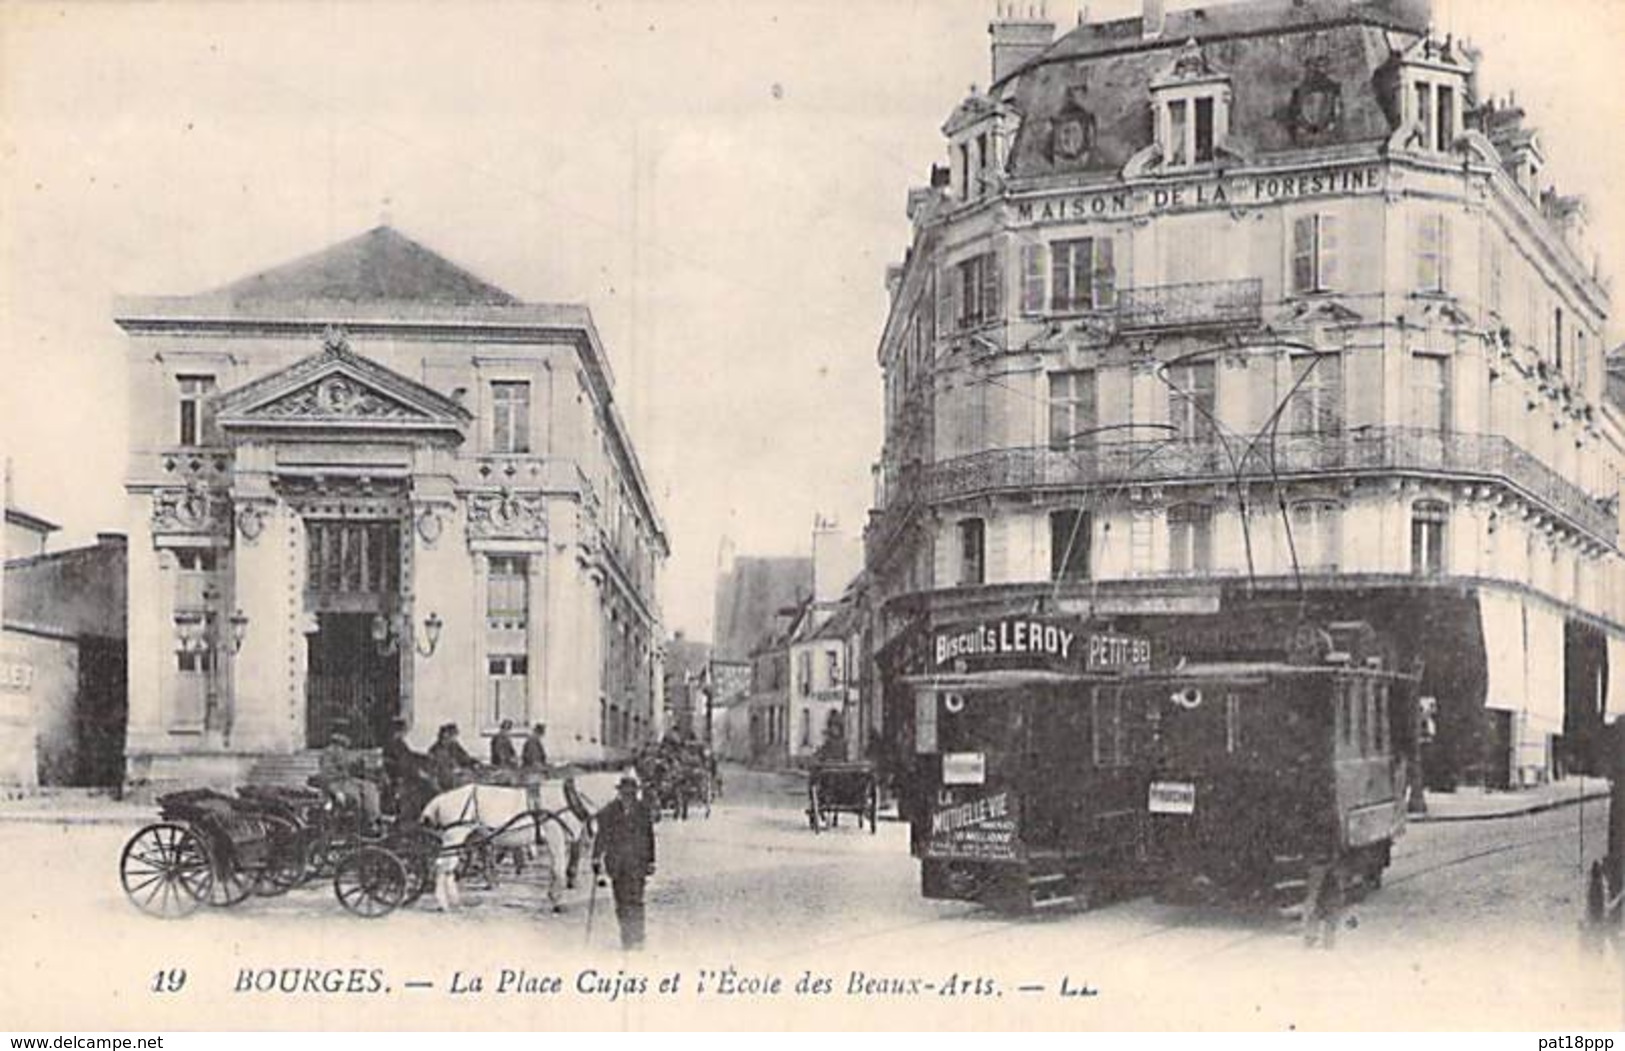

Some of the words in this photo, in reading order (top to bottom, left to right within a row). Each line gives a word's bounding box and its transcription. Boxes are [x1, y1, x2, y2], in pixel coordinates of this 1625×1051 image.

[1017, 193, 1127, 222] MAISON
[1154, 187, 1184, 207] DE
[1197, 184, 1226, 204] LA
[1254, 167, 1379, 199] FORESTINE
[1000, 620, 1074, 659] LEROY
